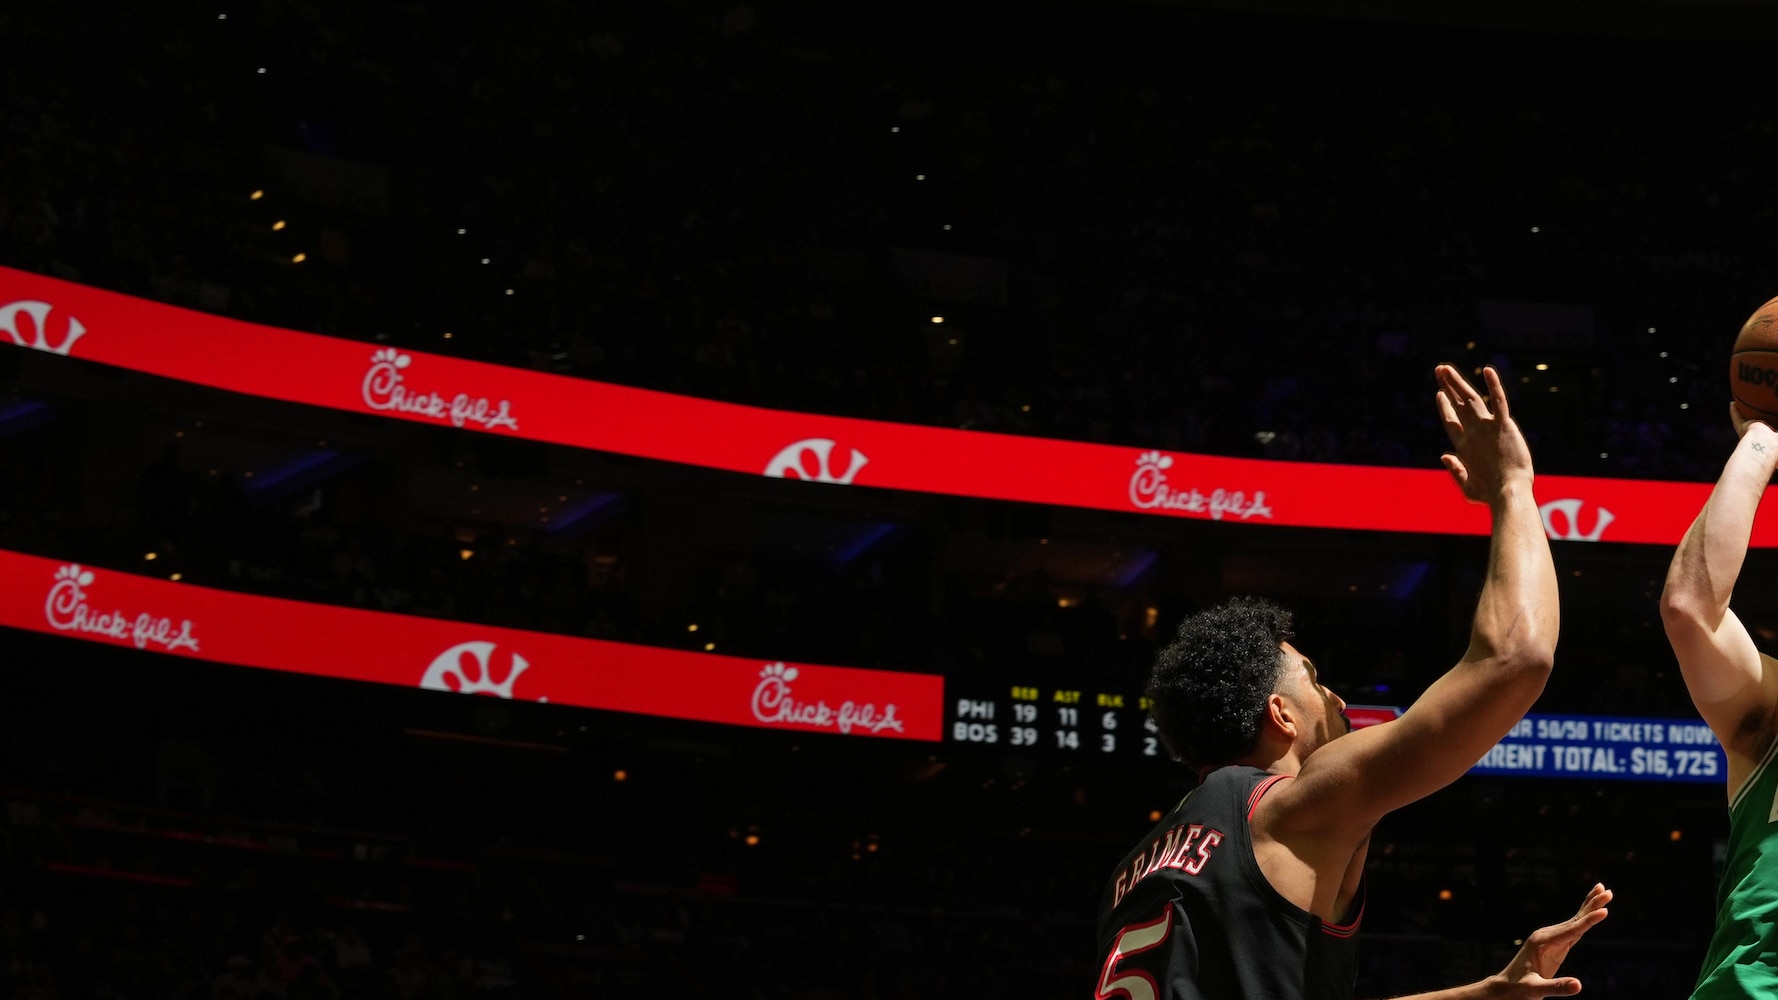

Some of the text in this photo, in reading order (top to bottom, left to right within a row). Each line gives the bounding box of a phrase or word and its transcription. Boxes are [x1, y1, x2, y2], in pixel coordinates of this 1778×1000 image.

[361, 347, 519, 431] Chick-fil-A
[1128, 450, 1273, 521] Chick-fil-A
[45, 564, 200, 651] Chick-fil-A
[751, 661, 904, 734] Chick-fil-A
[957, 699, 994, 720] PHI
[1014, 703, 1037, 723] 19
[1058, 707, 1078, 726] 11
[1102, 711, 1117, 730] 6
[1011, 686, 1039, 701] REB
[1053, 690, 1081, 704] AST
[1096, 693, 1124, 708] BLK
[953, 721, 1158, 756] BOS 39 14 3 2
[1537, 719, 1588, 740] 50/50
[1593, 721, 1664, 744] TICKETS
[1668, 724, 1718, 745] NOW
[1552, 746, 1626, 773] TOTAL:
[1631, 747, 1717, 778] $16,725
[1112, 824, 1224, 910] GRIMES
